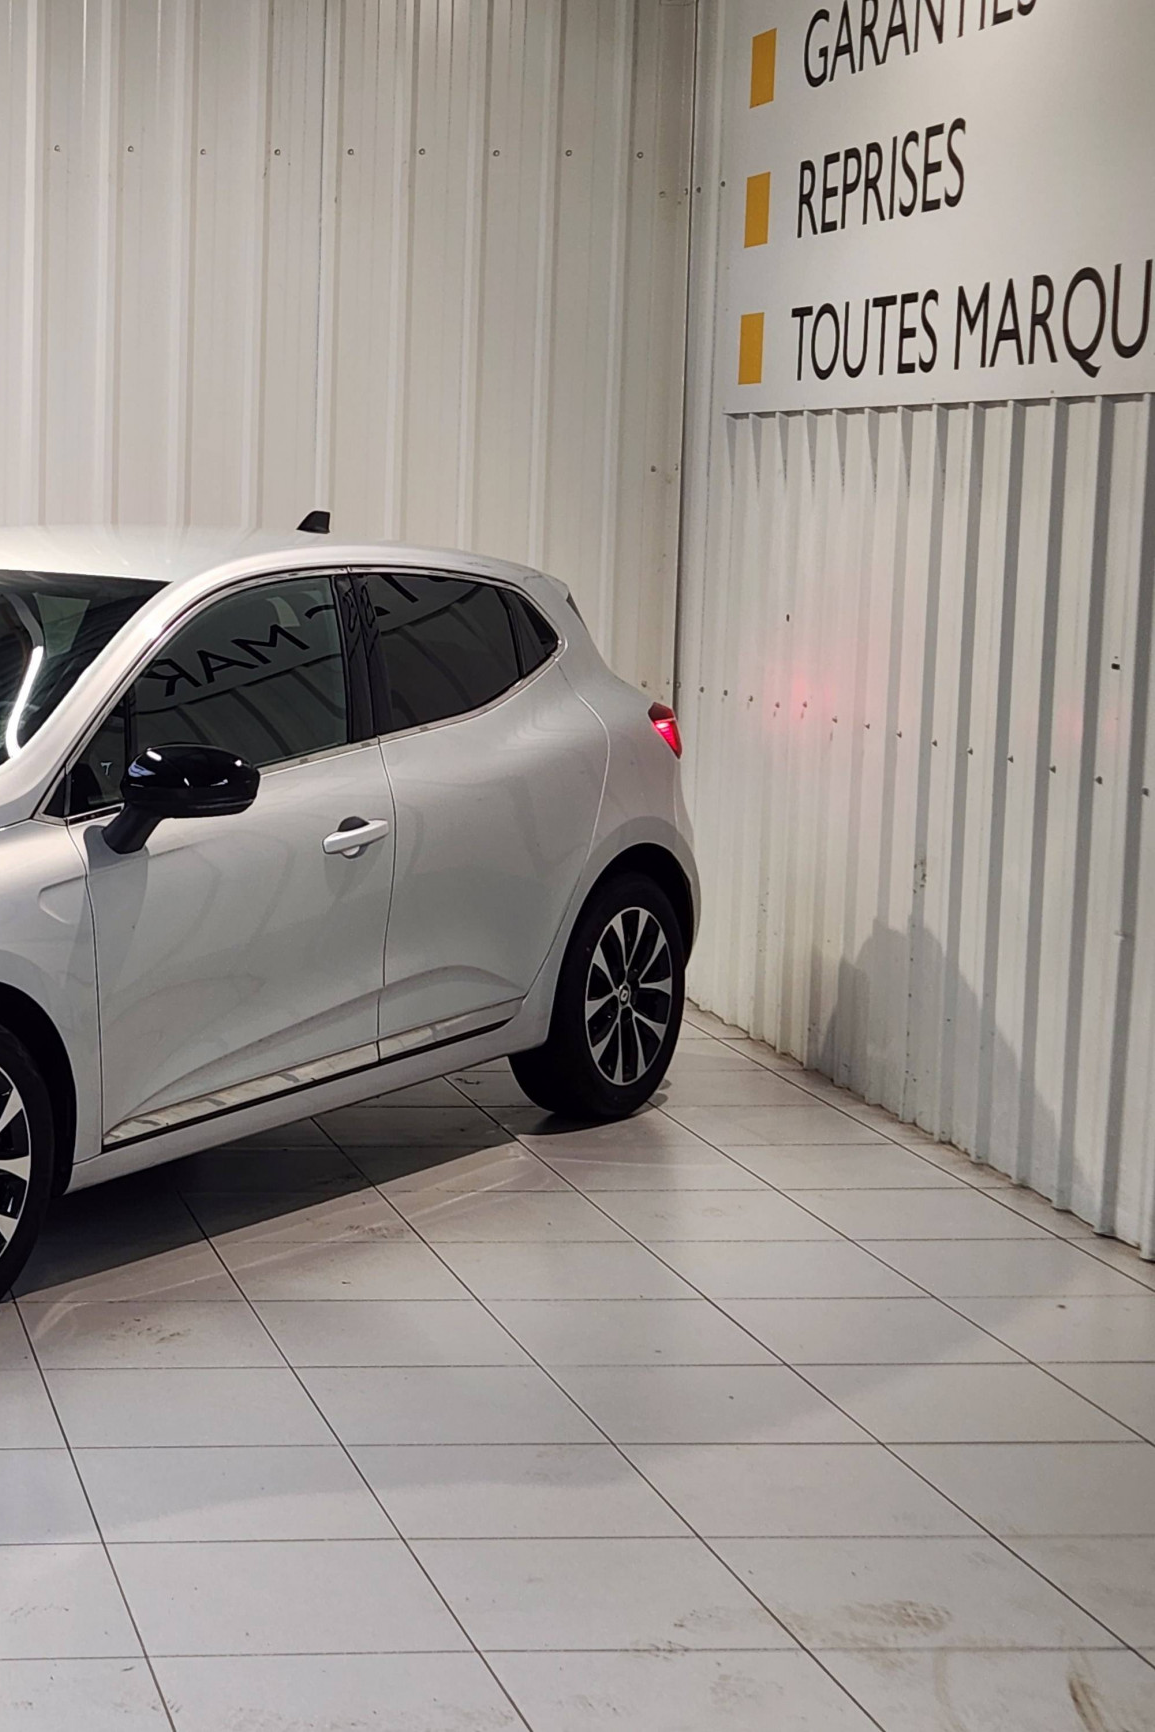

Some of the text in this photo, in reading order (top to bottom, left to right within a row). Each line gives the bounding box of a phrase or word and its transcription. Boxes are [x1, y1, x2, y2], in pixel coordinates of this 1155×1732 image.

[804, 0, 1037, 88] GARAN
[797, 117, 966, 238] REPRISES
[791, 259, 1153, 381] TOUTES MARQU
